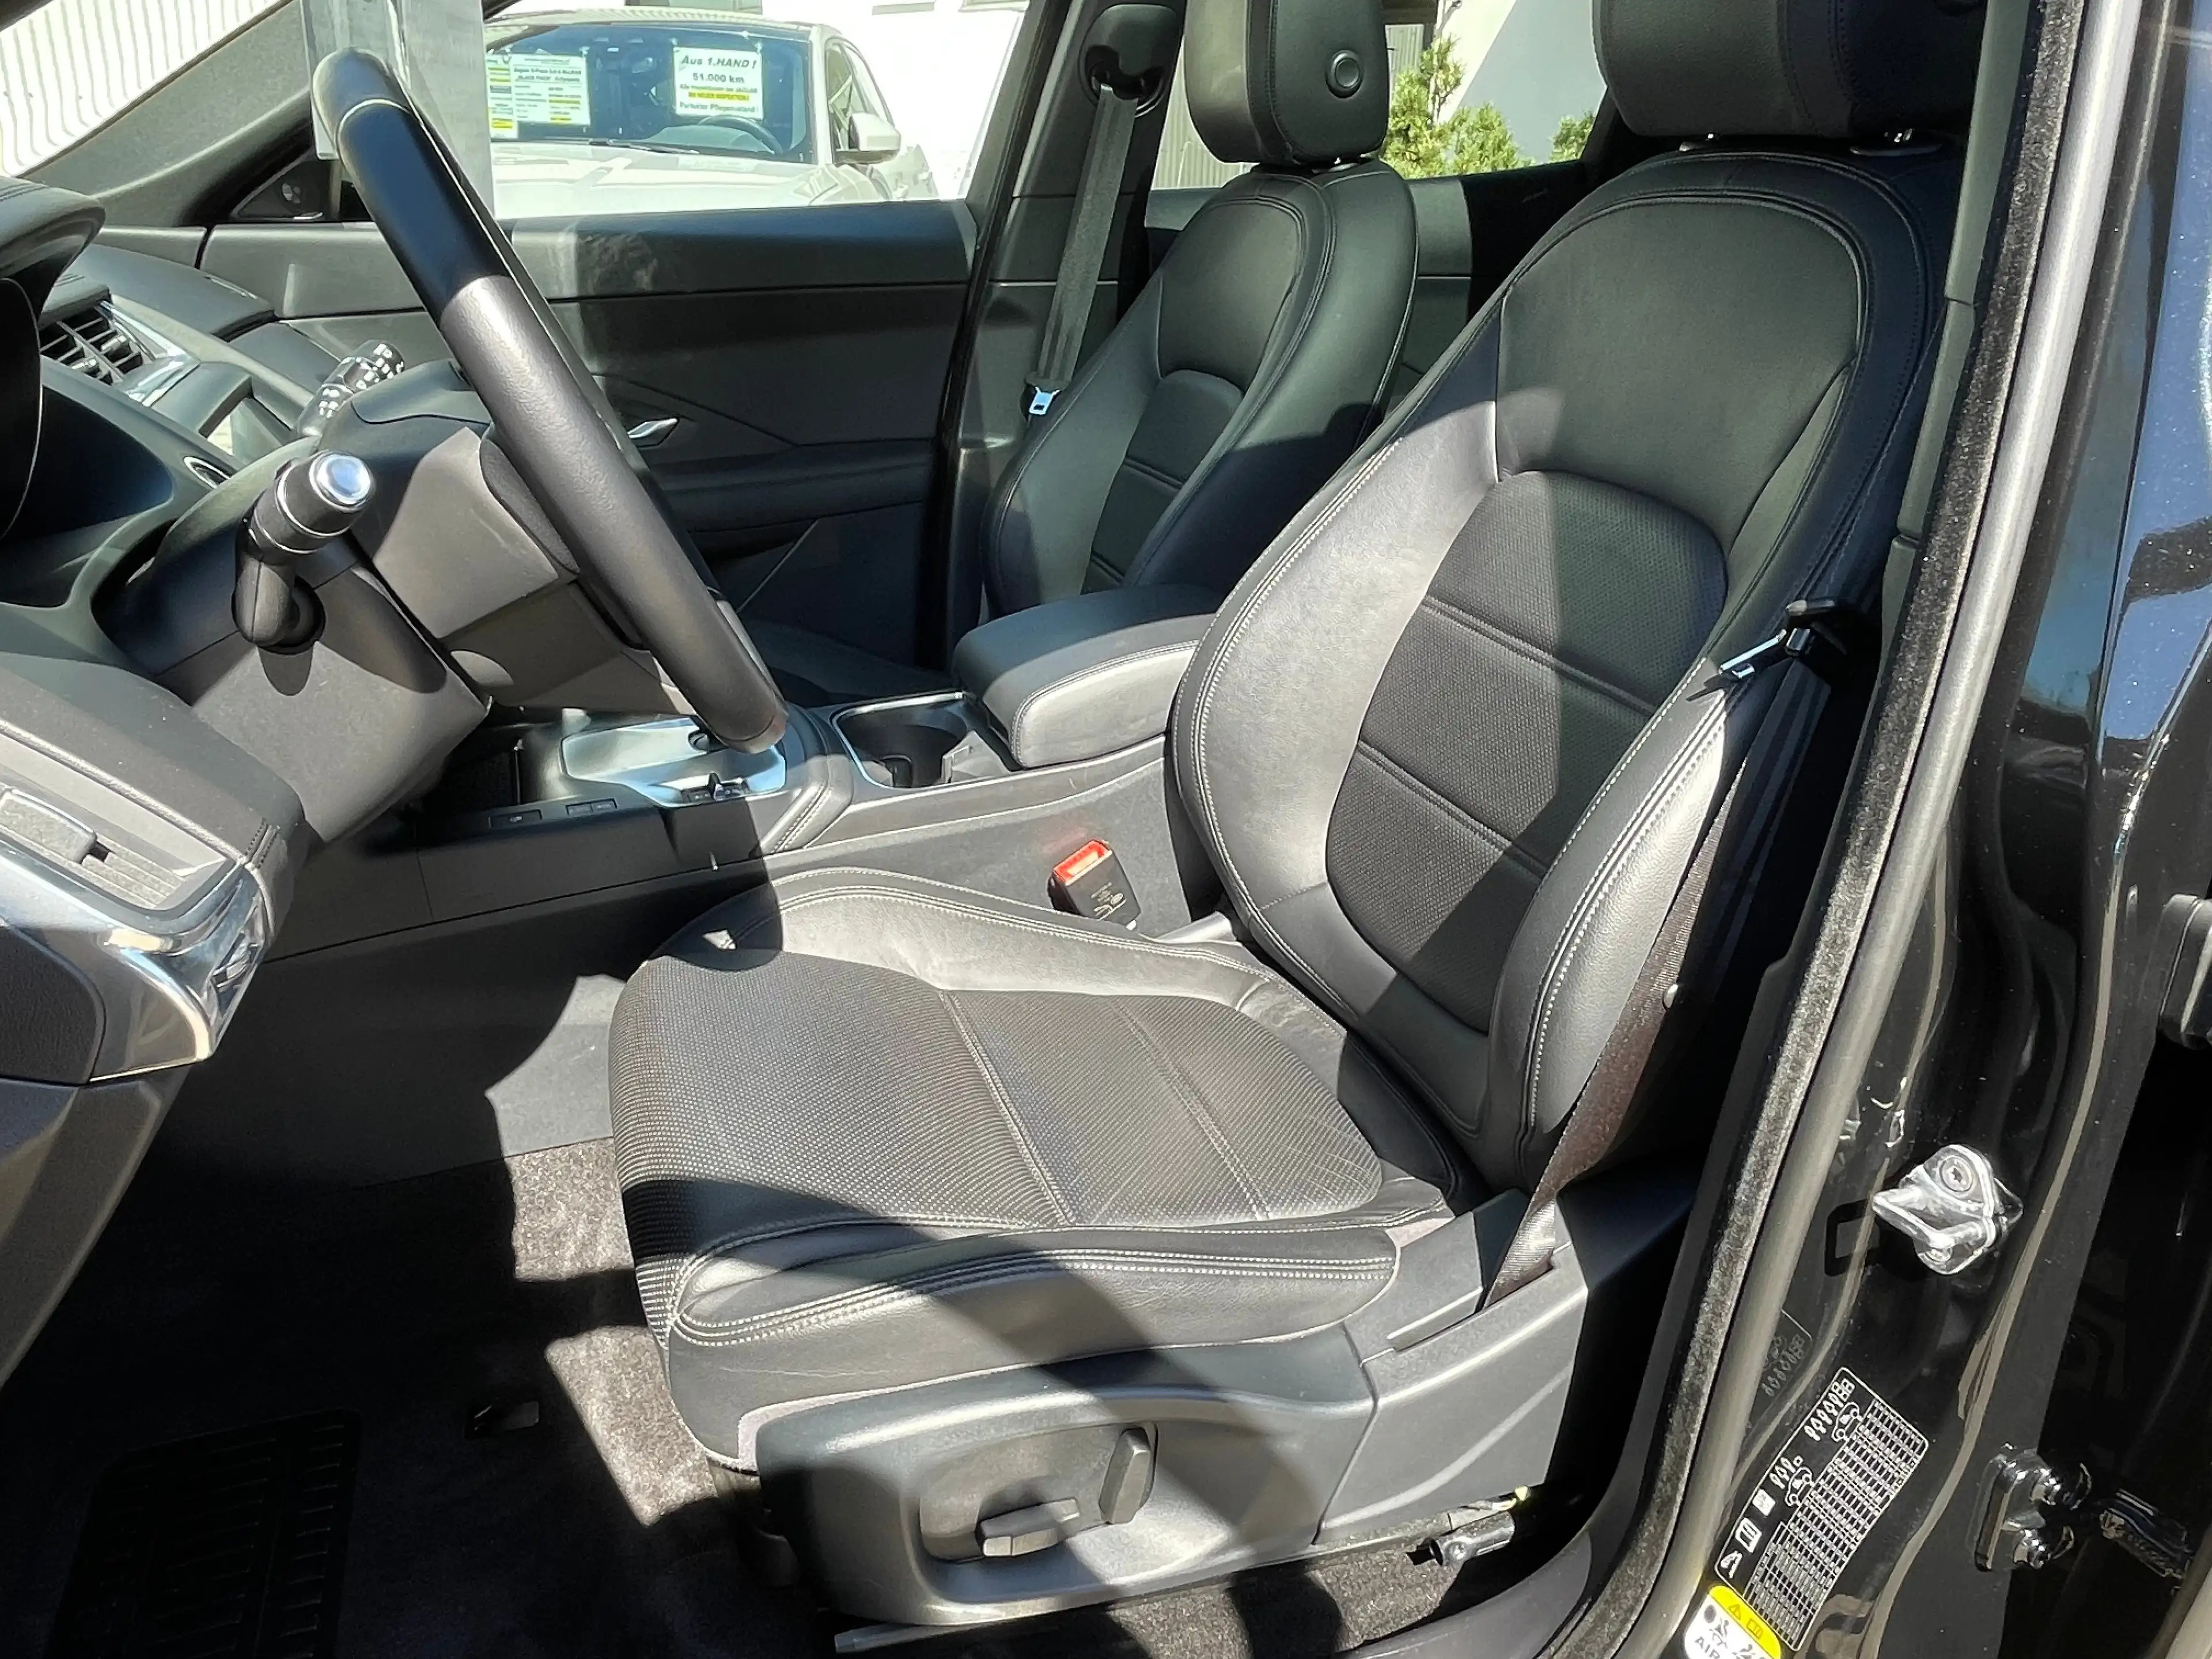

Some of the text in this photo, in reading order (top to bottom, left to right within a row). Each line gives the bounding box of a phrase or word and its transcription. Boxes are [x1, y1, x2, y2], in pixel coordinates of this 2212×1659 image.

[681, 55, 703, 65] Aus
[692, 73, 745, 84] 51.000 km
